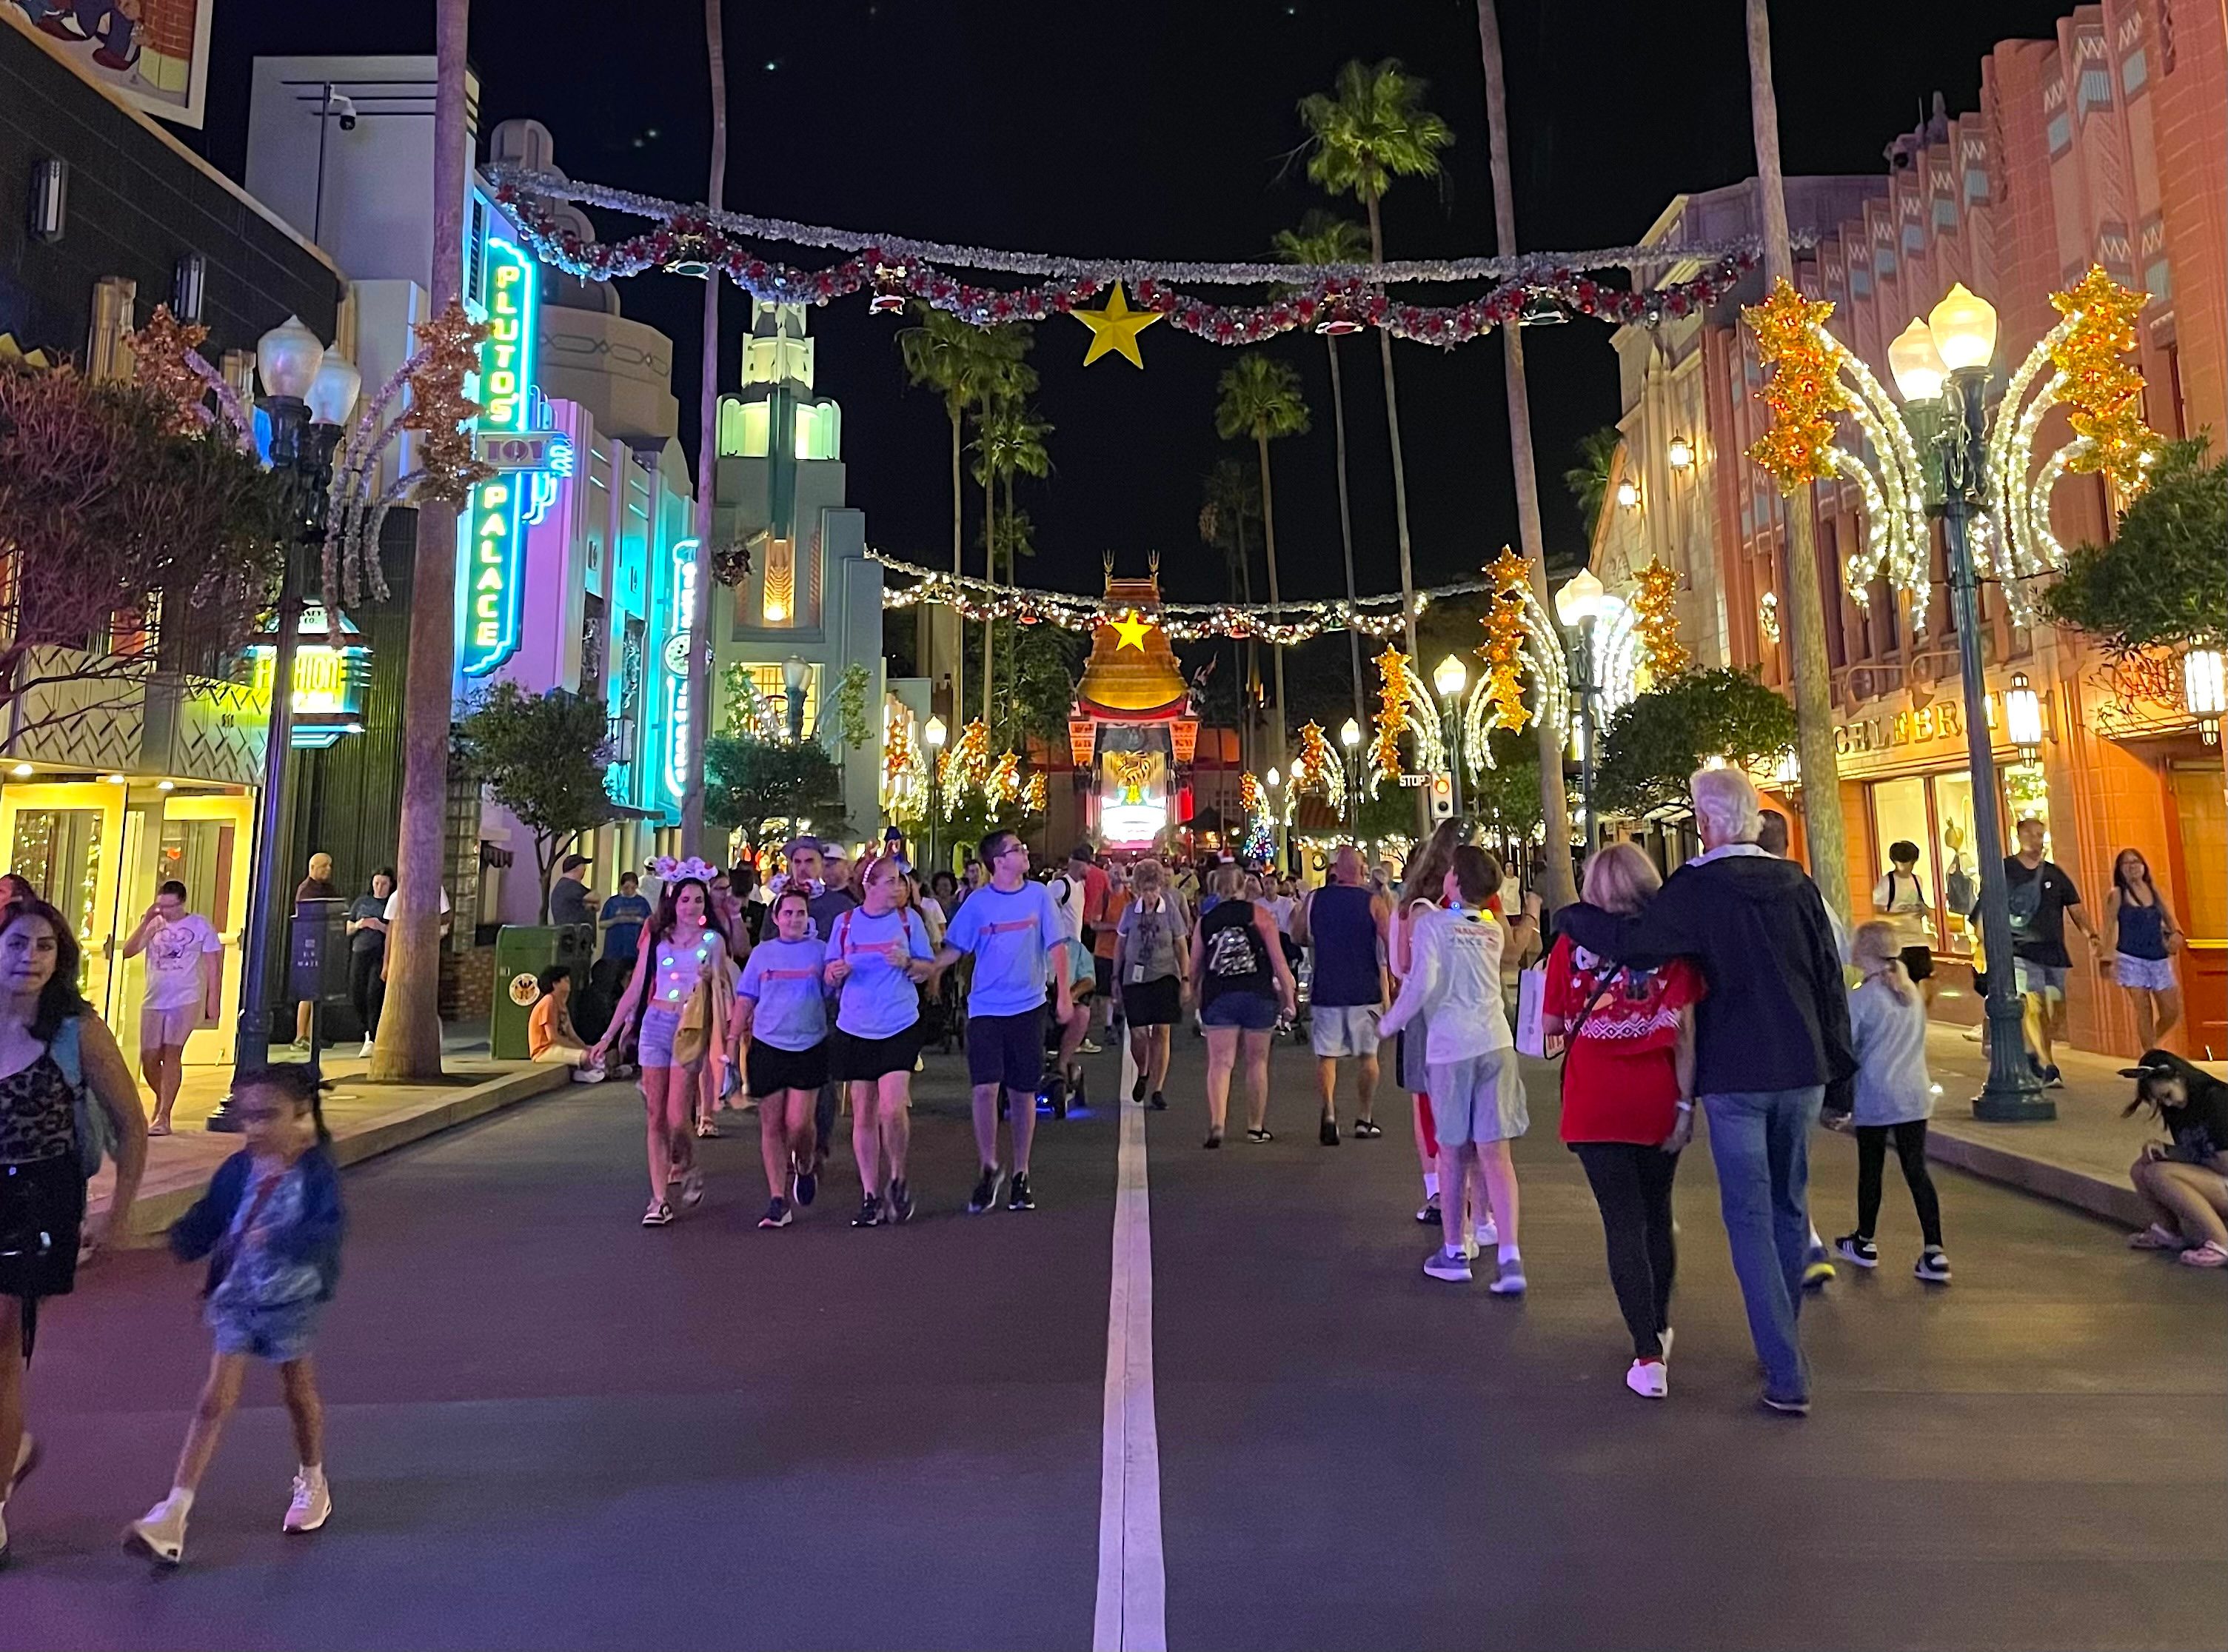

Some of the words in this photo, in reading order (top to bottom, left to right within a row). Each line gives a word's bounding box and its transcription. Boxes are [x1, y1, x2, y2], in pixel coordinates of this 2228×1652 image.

[486, 438, 546, 463] TOY
[476, 485, 507, 646] PALACE
[255, 655, 339, 689] FHION
[1399, 775, 1425, 787] STOP
